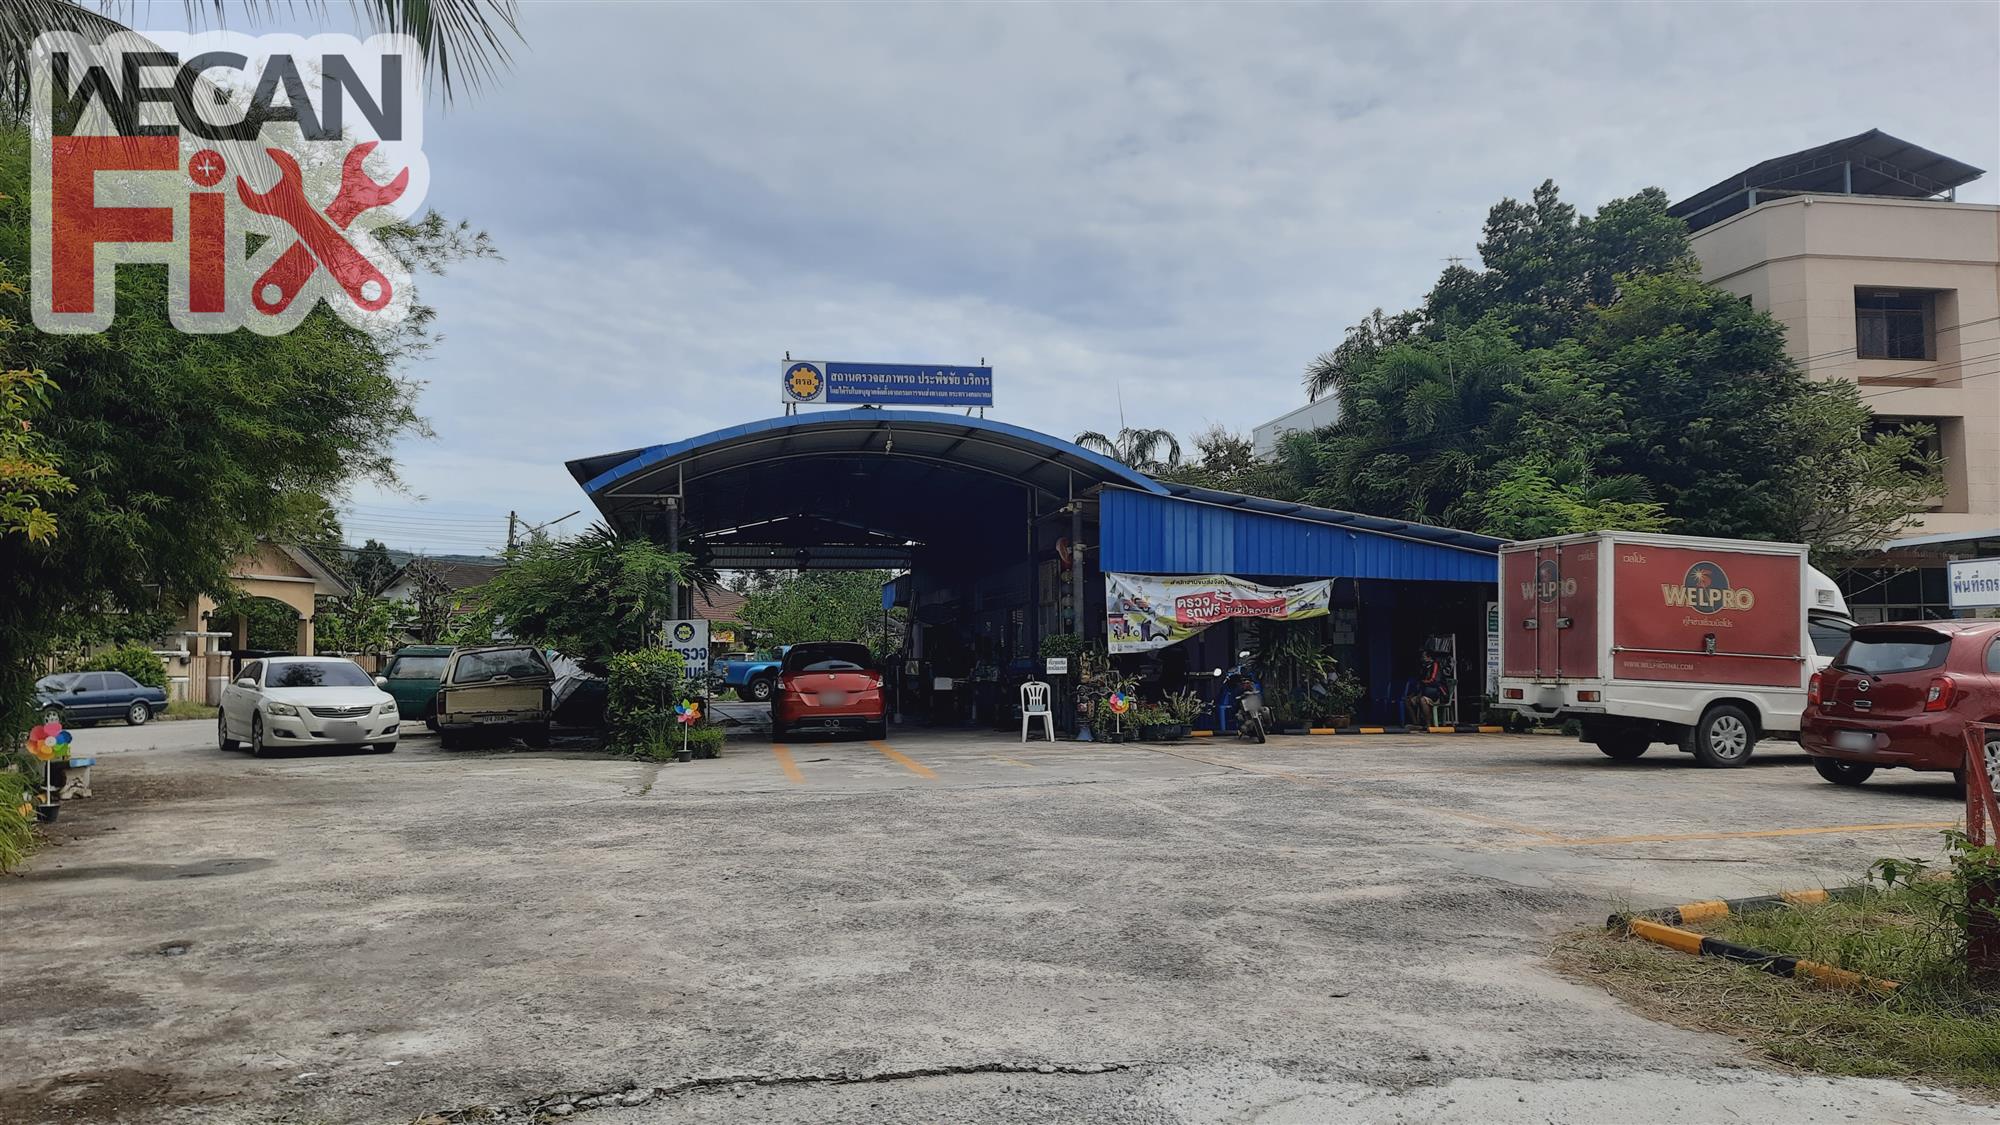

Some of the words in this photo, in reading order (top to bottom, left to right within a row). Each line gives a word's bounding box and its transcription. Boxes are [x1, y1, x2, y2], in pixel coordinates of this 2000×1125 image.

[831, 372, 915, 384] สถานตรวจสภาพรถ
[963, 373, 990, 386] บริการ
[1177, 597, 1211, 609] ตรวจ
[1661, 583, 1755, 611] WELPRO
[1186, 602, 1221, 618] รถฟรี
